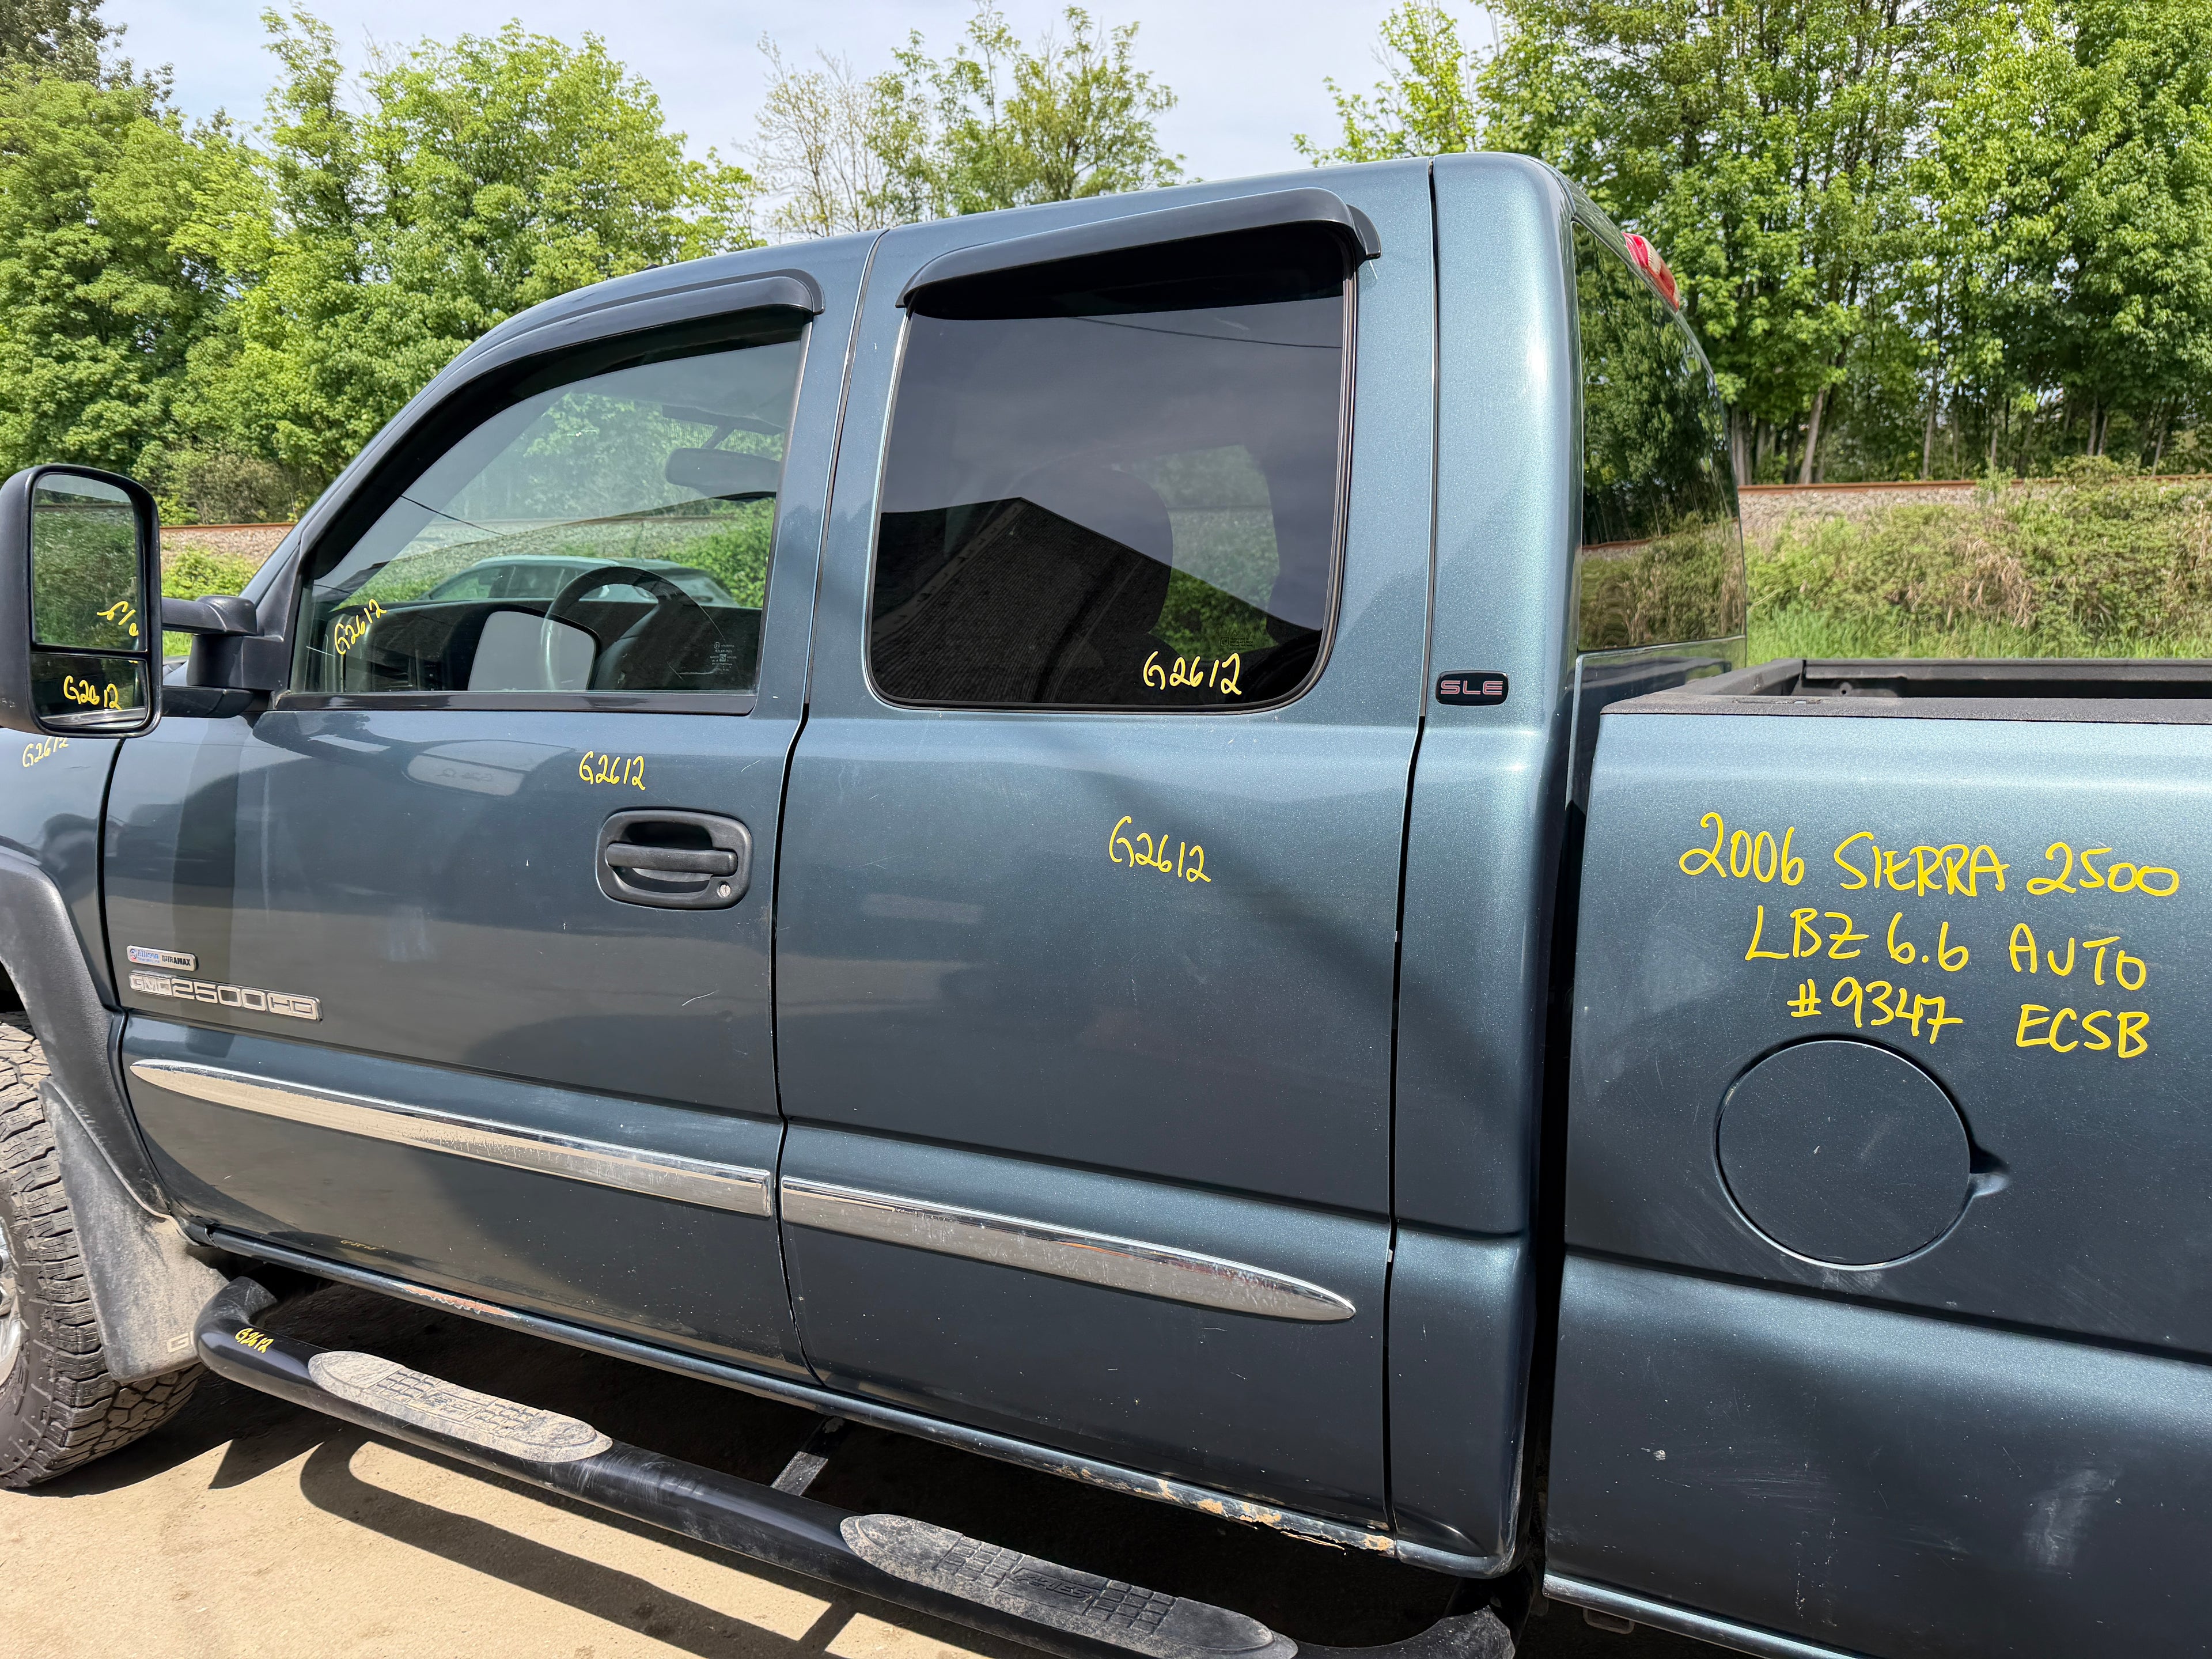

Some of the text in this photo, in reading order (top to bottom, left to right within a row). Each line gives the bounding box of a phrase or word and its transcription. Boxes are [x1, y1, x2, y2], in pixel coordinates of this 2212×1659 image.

[335, 599, 388, 656] G2612
[63, 675, 123, 710] G2612
[1143, 651, 1242, 695] G2612
[1441, 680, 1503, 695] SLE
[22, 736, 69, 767] G2612
[579, 751, 646, 790] G2612
[1109, 815, 1211, 882] G2612
[1679, 812, 2180, 897] 2006 SIERRA 2500
[161, 955, 191, 967] DURAMAX
[1745, 905, 2147, 991] LBZ 6.6 AUTO
[1787, 976, 2151, 1059] #9347 ECSB
[234, 1328, 275, 1354] G2612
